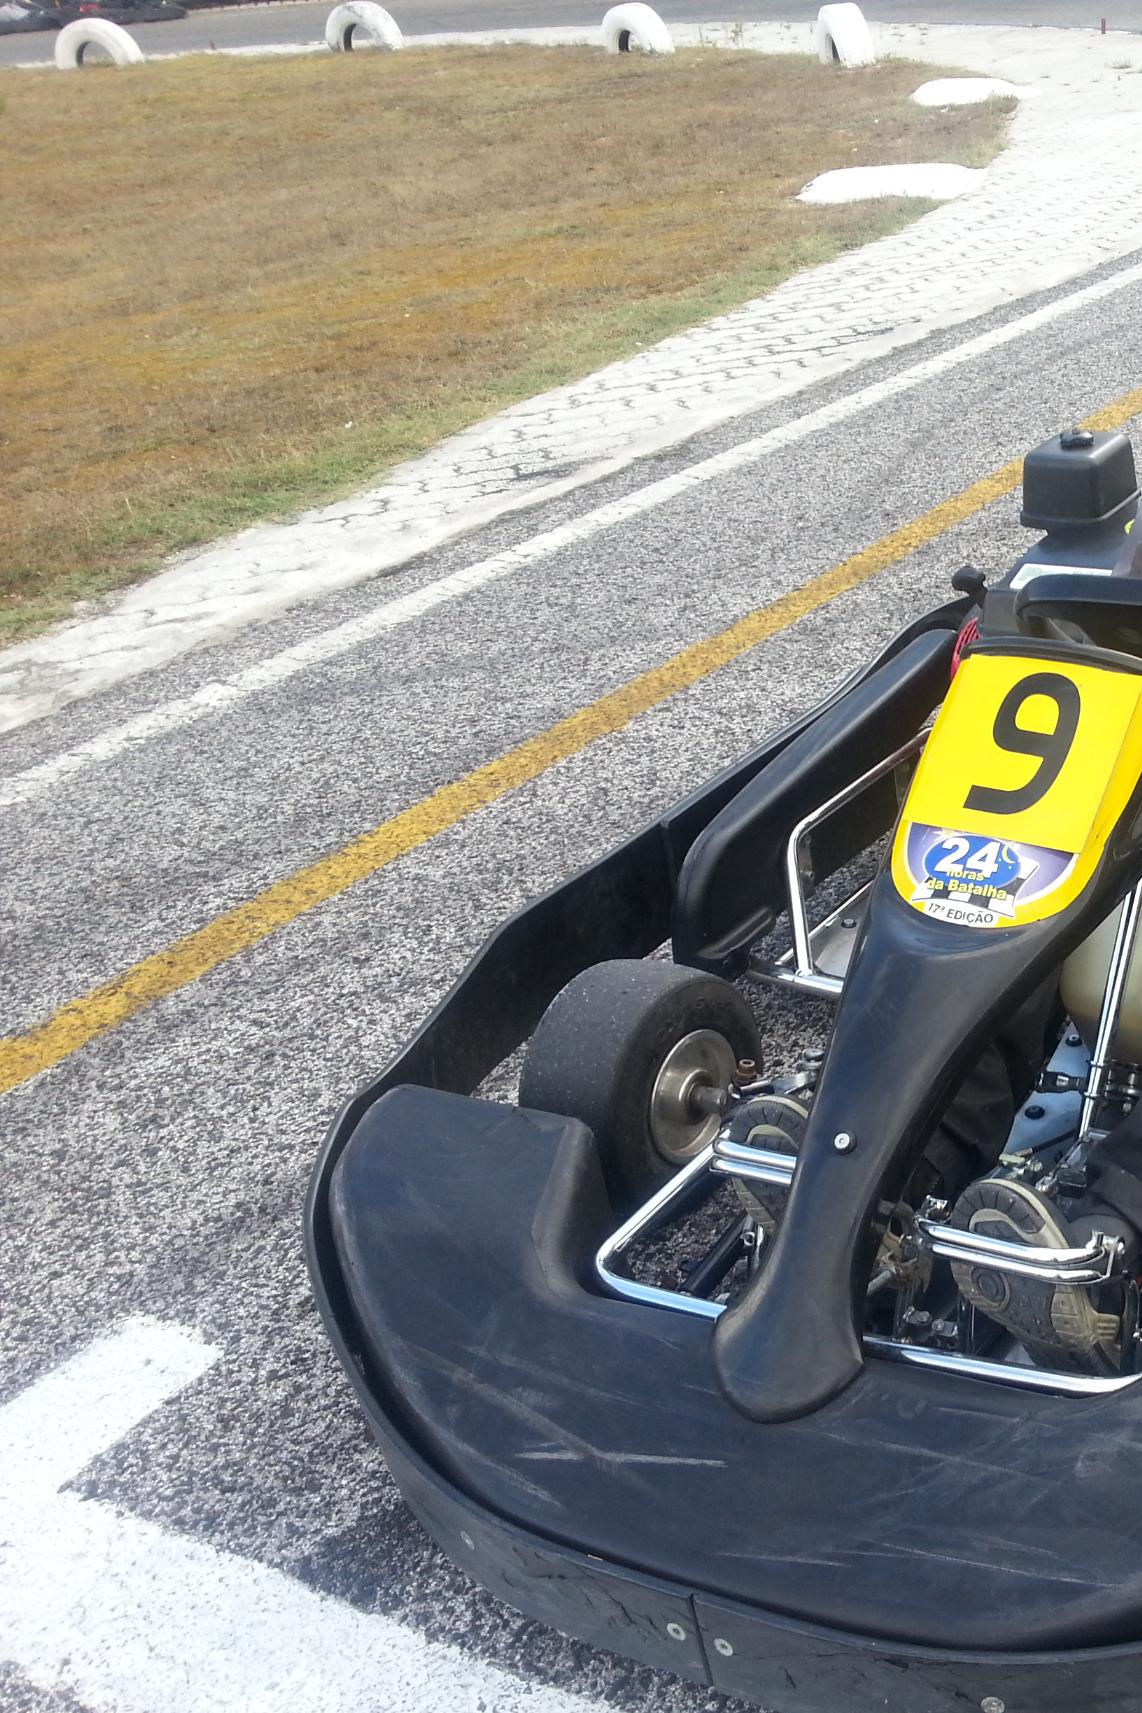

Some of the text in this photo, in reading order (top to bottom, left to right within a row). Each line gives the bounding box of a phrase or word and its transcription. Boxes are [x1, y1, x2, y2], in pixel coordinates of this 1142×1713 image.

[963, 672, 1081, 815] 9
[934, 837, 1001, 878] 24
[927, 878, 1007, 900] da Batalha
[946, 908, 994, 924] EDIÇÃO
